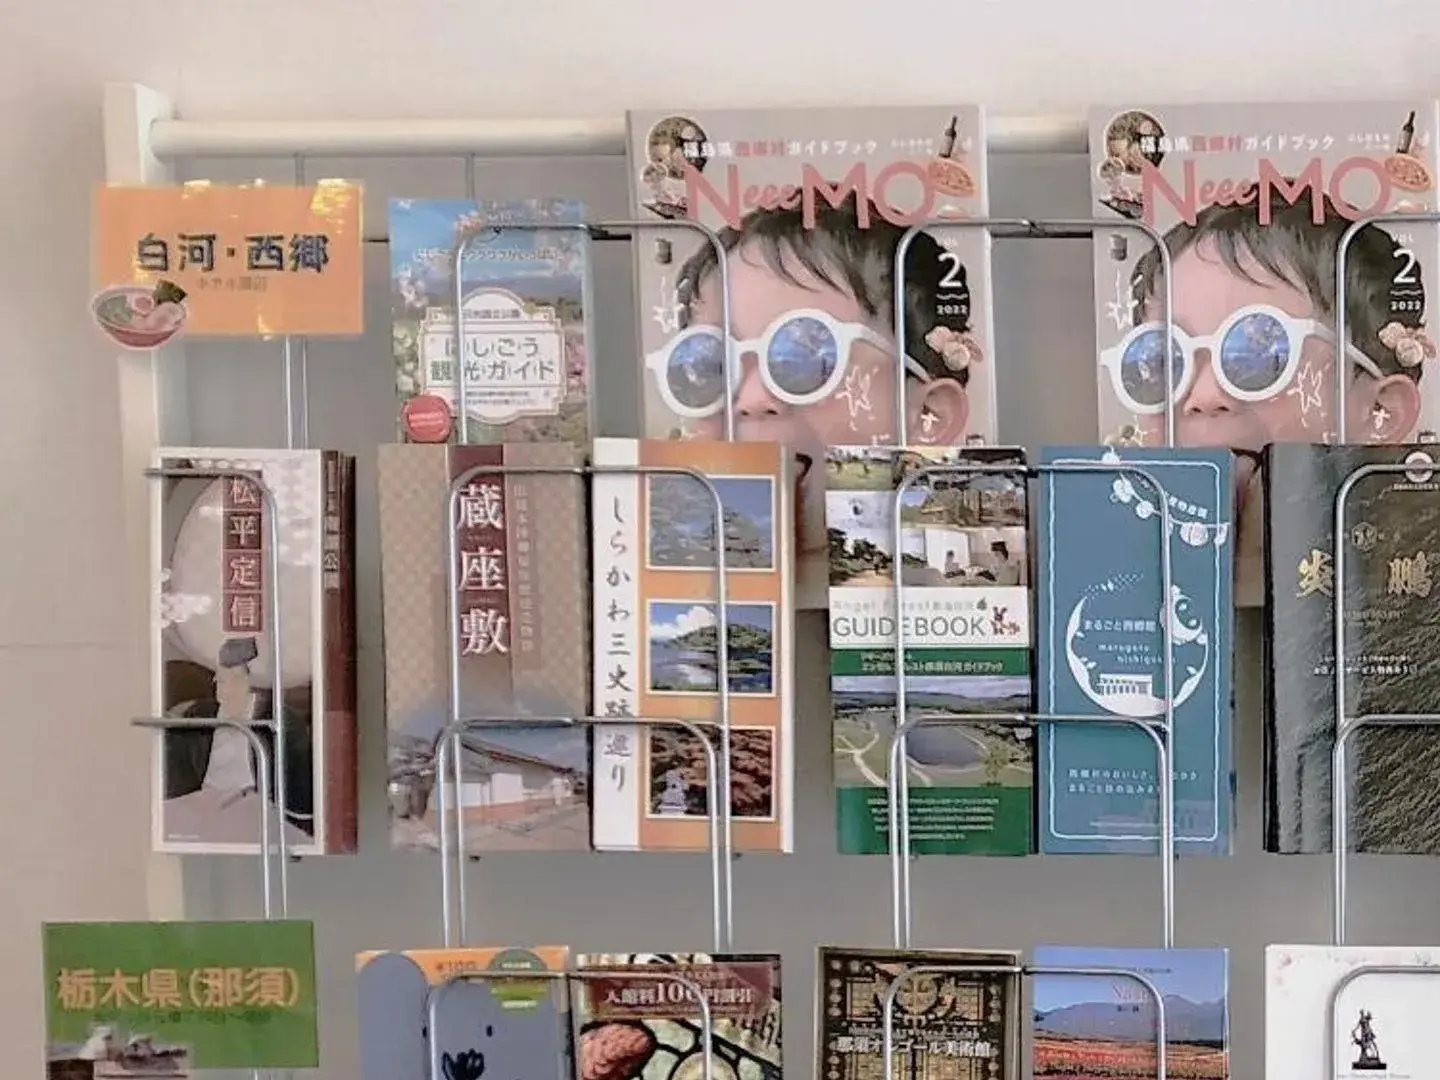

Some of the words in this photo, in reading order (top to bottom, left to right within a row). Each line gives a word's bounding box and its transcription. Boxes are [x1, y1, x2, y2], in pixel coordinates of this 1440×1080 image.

[136, 232, 330, 273] 白河・西郷
[937, 252, 963, 288] 2
[1393, 249, 1417, 283] 2
[225, 474, 261, 631] 松平定信
[456, 481, 509, 657] 蔵座敷
[57, 966, 300, 1009] 栃木県(那須)
